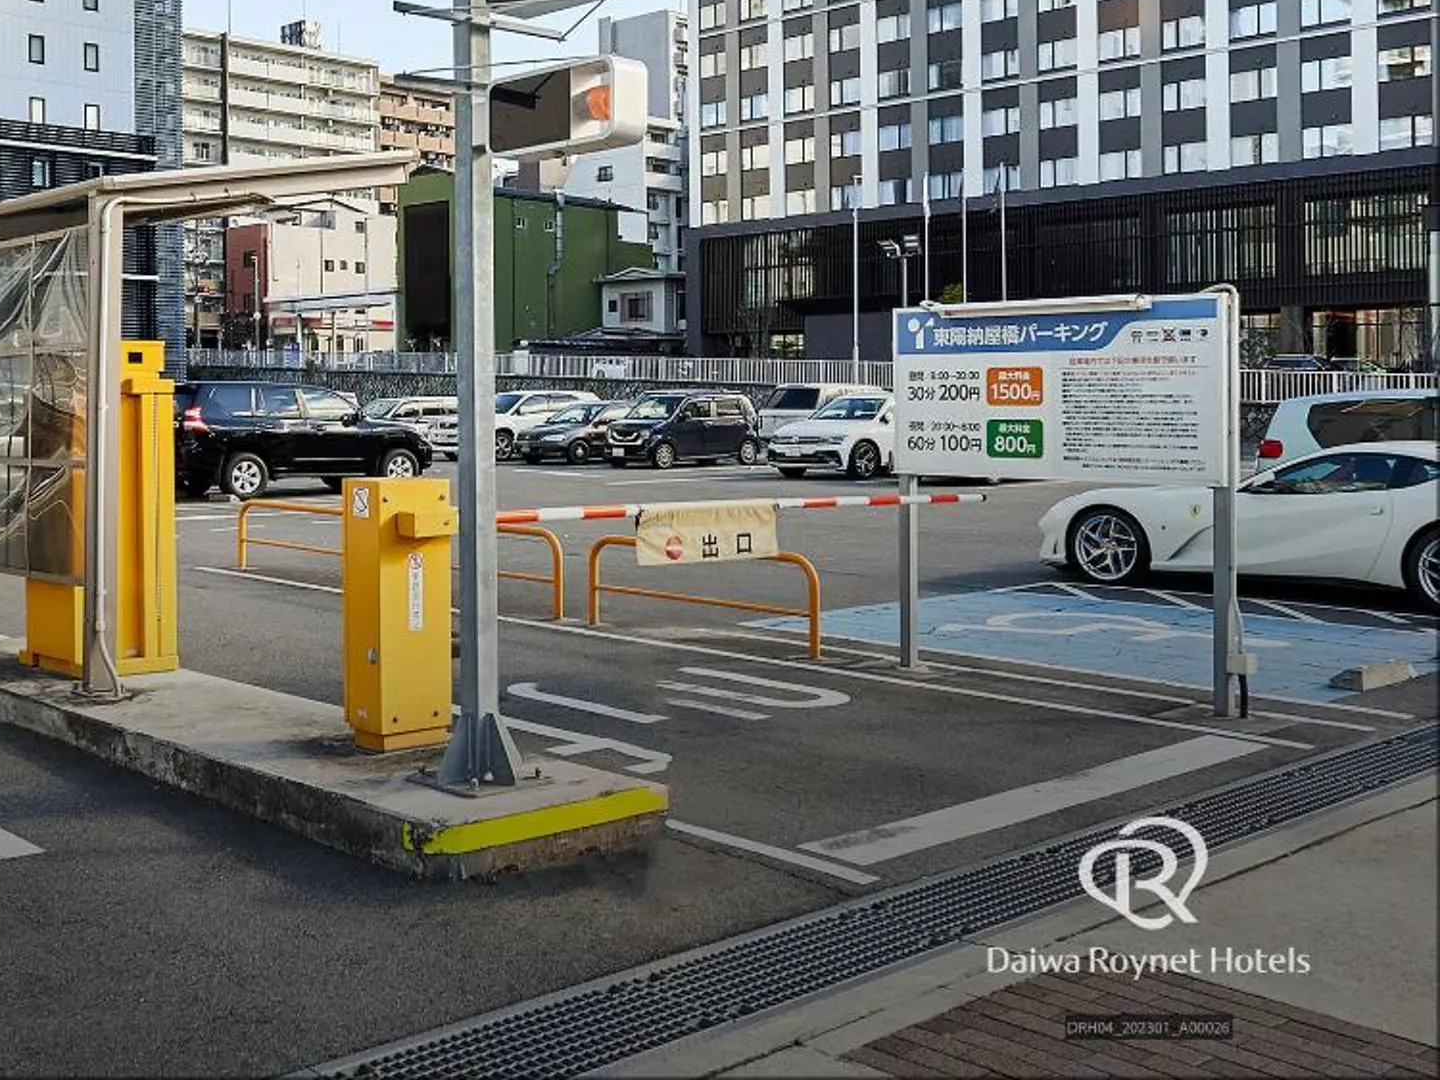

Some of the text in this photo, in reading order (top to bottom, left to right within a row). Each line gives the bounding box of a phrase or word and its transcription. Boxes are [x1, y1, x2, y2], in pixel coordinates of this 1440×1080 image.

[932, 321, 1108, 347] 東陽納屋橋パーキング
[907, 384, 981, 401] 30分 200円
[991, 383, 1040, 401] 1500円
[907, 434, 982, 451] 60分 100円
[994, 436, 1036, 454] 800円
[702, 532, 752, 559] 出口
